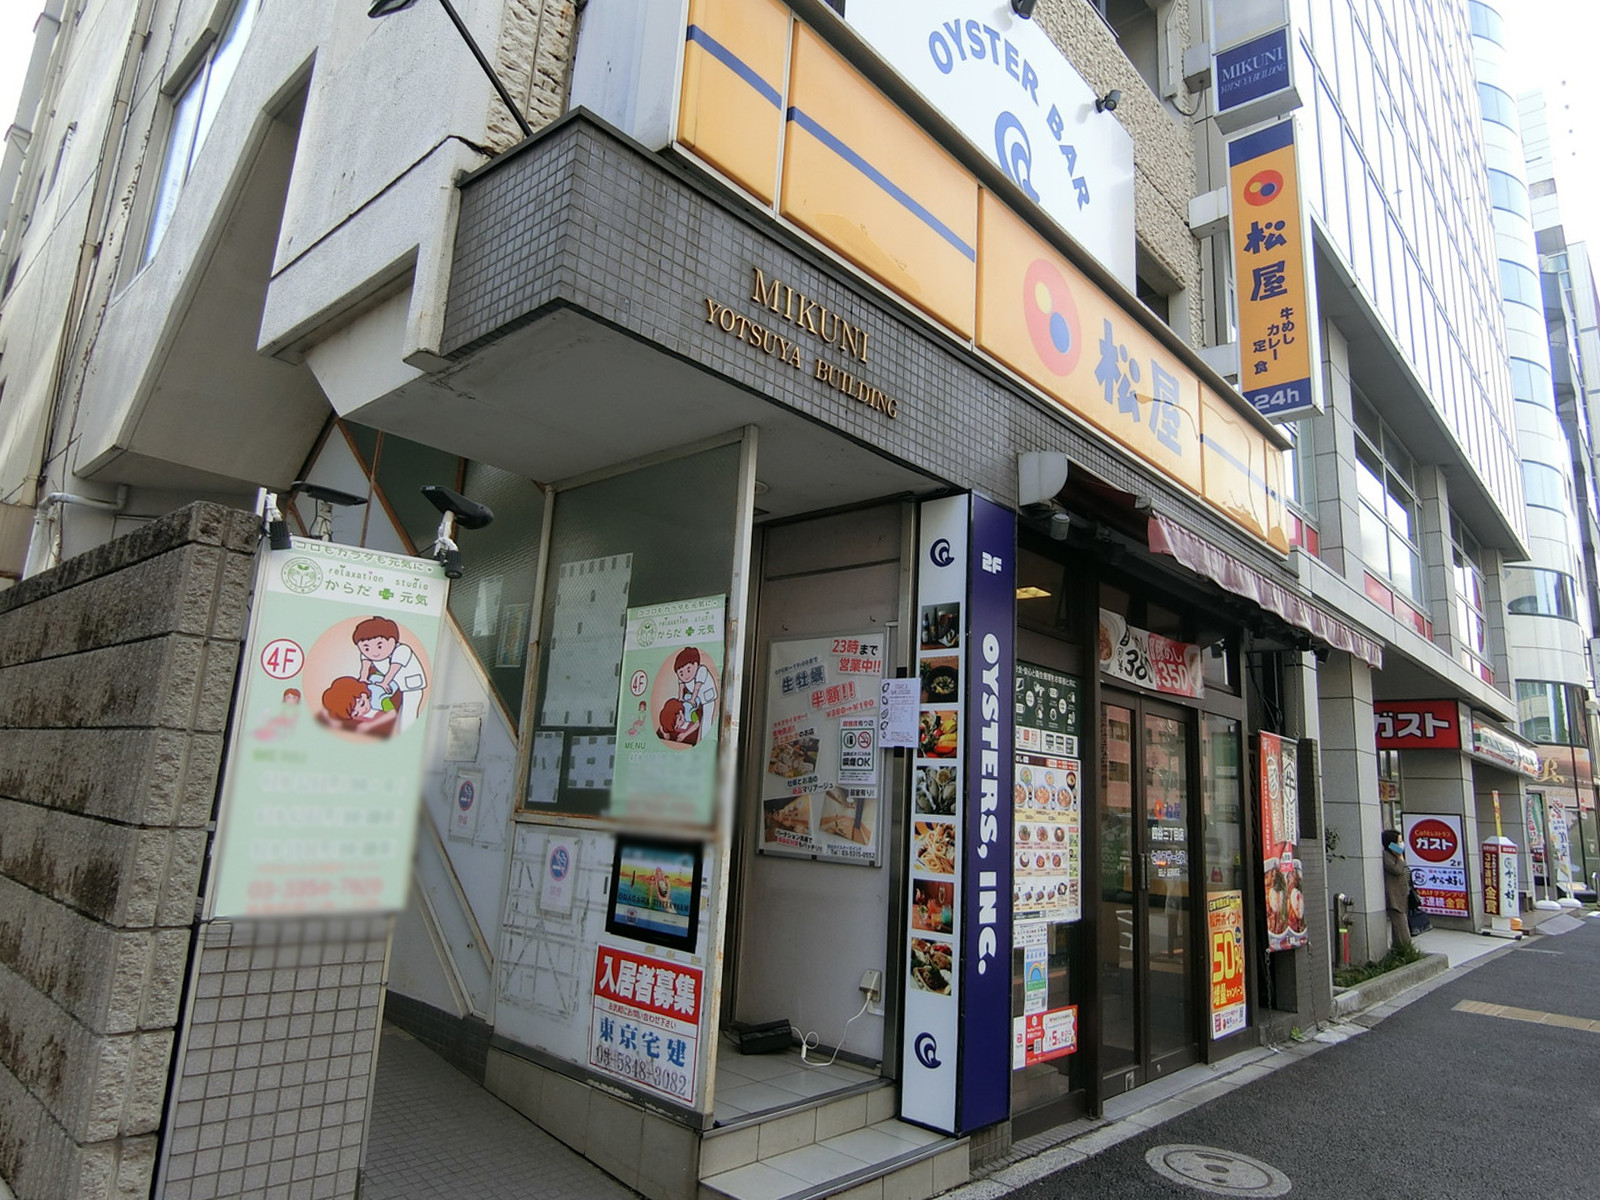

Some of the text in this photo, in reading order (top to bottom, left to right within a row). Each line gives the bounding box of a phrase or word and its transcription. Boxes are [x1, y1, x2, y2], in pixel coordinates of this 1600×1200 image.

[1222, 47, 1284, 82] MIKUNI
[928, 18, 1090, 212] OYSTER BAR
[1243, 219, 1288, 302] 松屋
[751, 267, 869, 364] MIKUNI
[1280, 307, 1295, 346] 牛めし
[1253, 339, 1268, 375] 定食
[1266, 323, 1282, 361] カレー
[705, 298, 898, 419] YOTSUYA BUILDING
[1094, 318, 1182, 456] 松屋
[1254, 387, 1300, 410] 24h
[296, 541, 425, 571] コロもカラダも元気に
[982, 551, 1002, 574] 2F
[324, 579, 428, 607] からだ 元気
[329, 566, 384, 583] relaxation
[395, 577, 429, 591] studio
[697, 624, 716, 636] 元気
[267, 646, 296, 674] 4F
[832, 639, 878, 656] 23時まで
[839, 657, 881, 673] 営業中!!
[632, 675, 645, 693] 4F
[1374, 712, 1450, 739] ガスト
[625, 741, 645, 750] MENU
[977, 631, 1000, 976] OYSTERS, INC.
[1416, 837, 1453, 850] ガスト
[599, 956, 696, 1016] 入居者募集
[600, 1017, 687, 1067] 東京宅建
[596, 1045, 687, 1097] 03-5848-3082
